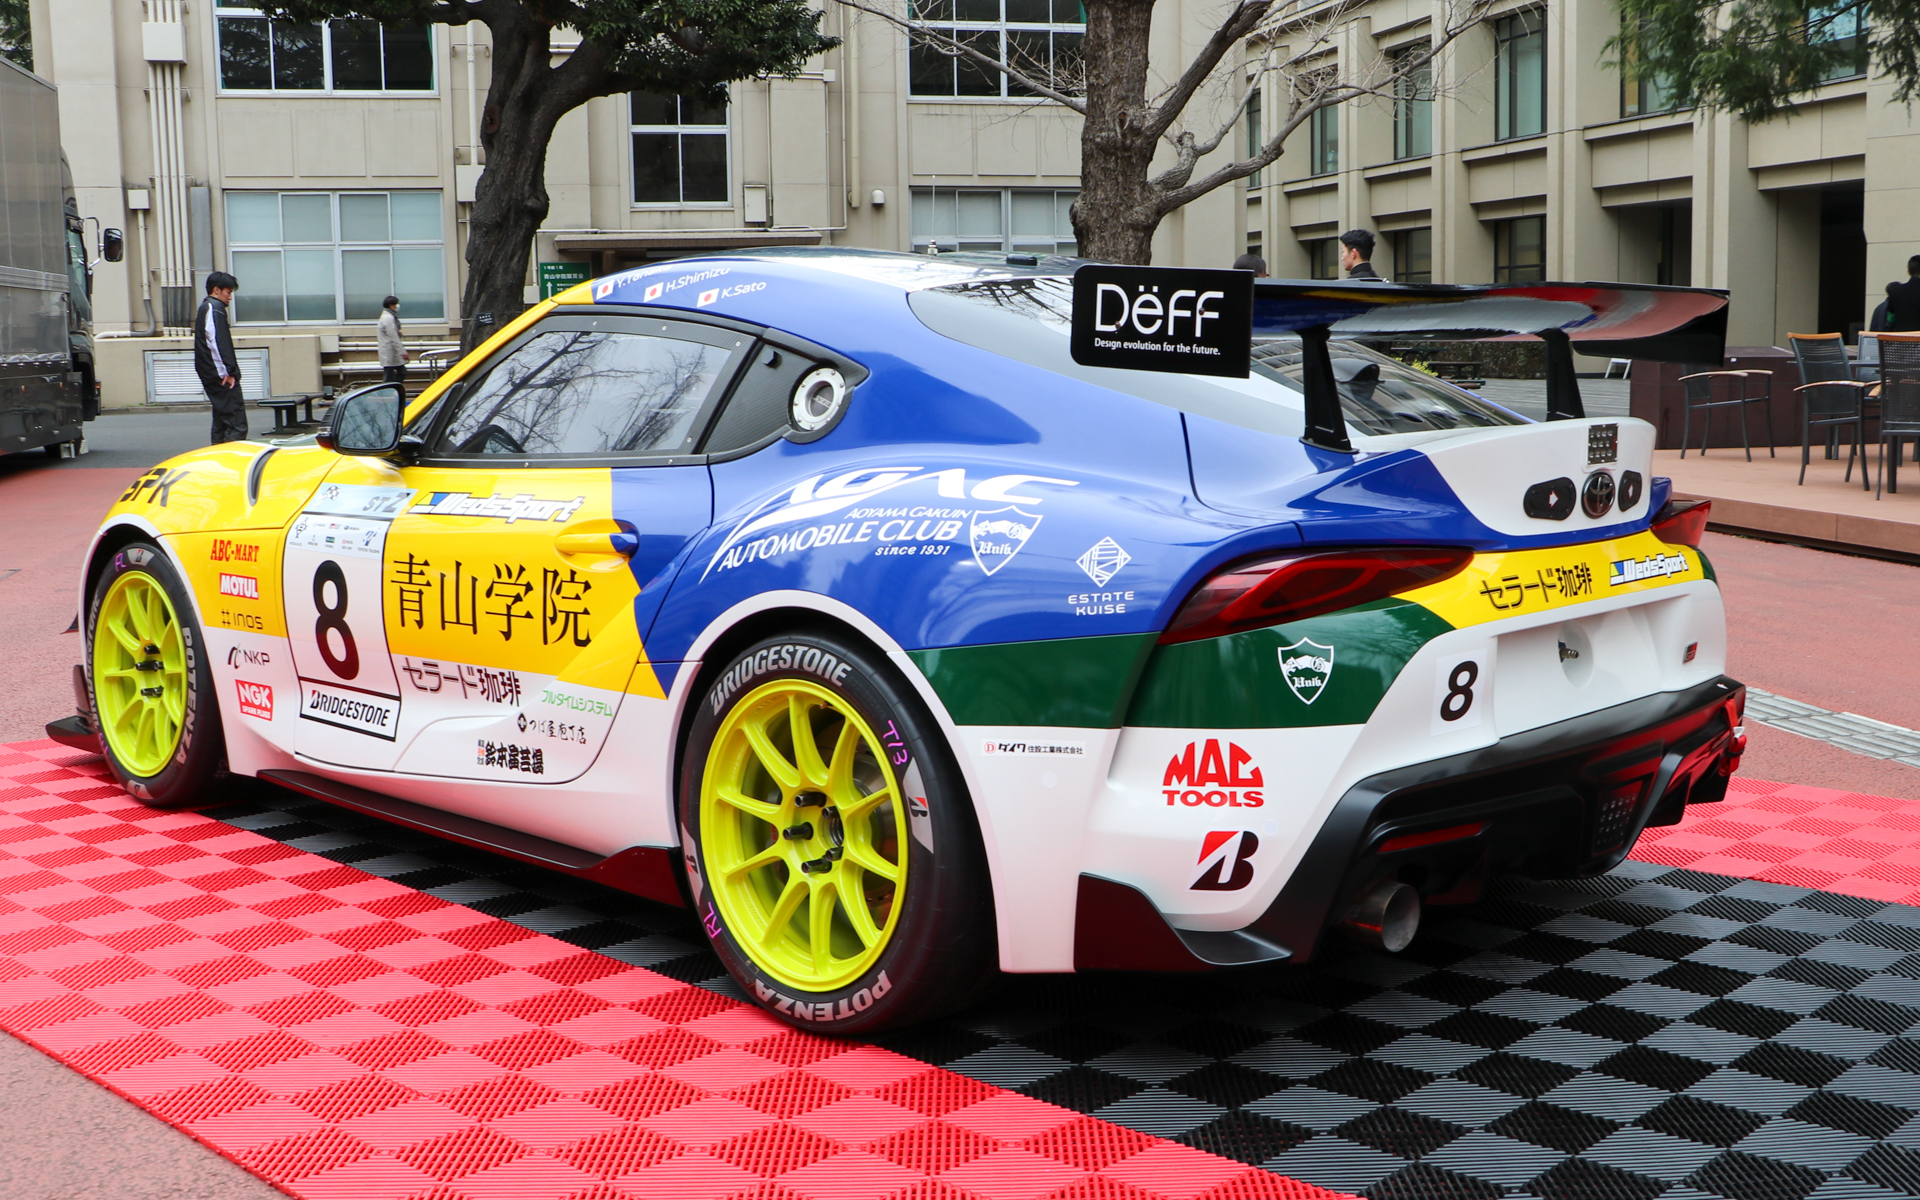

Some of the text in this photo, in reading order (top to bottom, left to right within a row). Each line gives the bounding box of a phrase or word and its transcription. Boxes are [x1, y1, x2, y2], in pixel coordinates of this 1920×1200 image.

[665, 267, 731, 293] H.Shimizu
[721, 281, 767, 299] K.Sato
[1094, 337, 1221, 356] Design evolution for the future.
[430, 491, 586, 524] WedsSport
[844, 506, 973, 520] AOYAMA GAKUIN
[210, 539, 259, 562] ABC-MART
[717, 519, 963, 572] AUTOMOBILE CLUB
[874, 543, 951, 556] since 1931
[1622, 551, 1689, 579] WedsSport
[220, 574, 259, 598] MOTUL
[390, 552, 592, 647] 青山学院
[1068, 590, 1135, 605] ESTATE
[1479, 562, 1593, 610] セラード珈琲
[313, 560, 360, 681] 8
[1075, 604, 1126, 616] KUISE
[243, 650, 271, 666] NKP
[402, 657, 522, 707] セラード珈琲
[710, 644, 852, 716] BRIDGESTONE
[1440, 660, 1478, 721] 8
[176, 627, 197, 765] POTENZA
[236, 682, 272, 709] NGK
[310, 689, 390, 727] BRIDGESTONE
[541, 690, 614, 717] フルタイムシステム
[256, 709, 271, 719] PLUGS
[1162, 738, 1264, 788] MAC
[1162, 789, 1264, 808] TOOLS
[755, 969, 892, 1021] POTENZA
